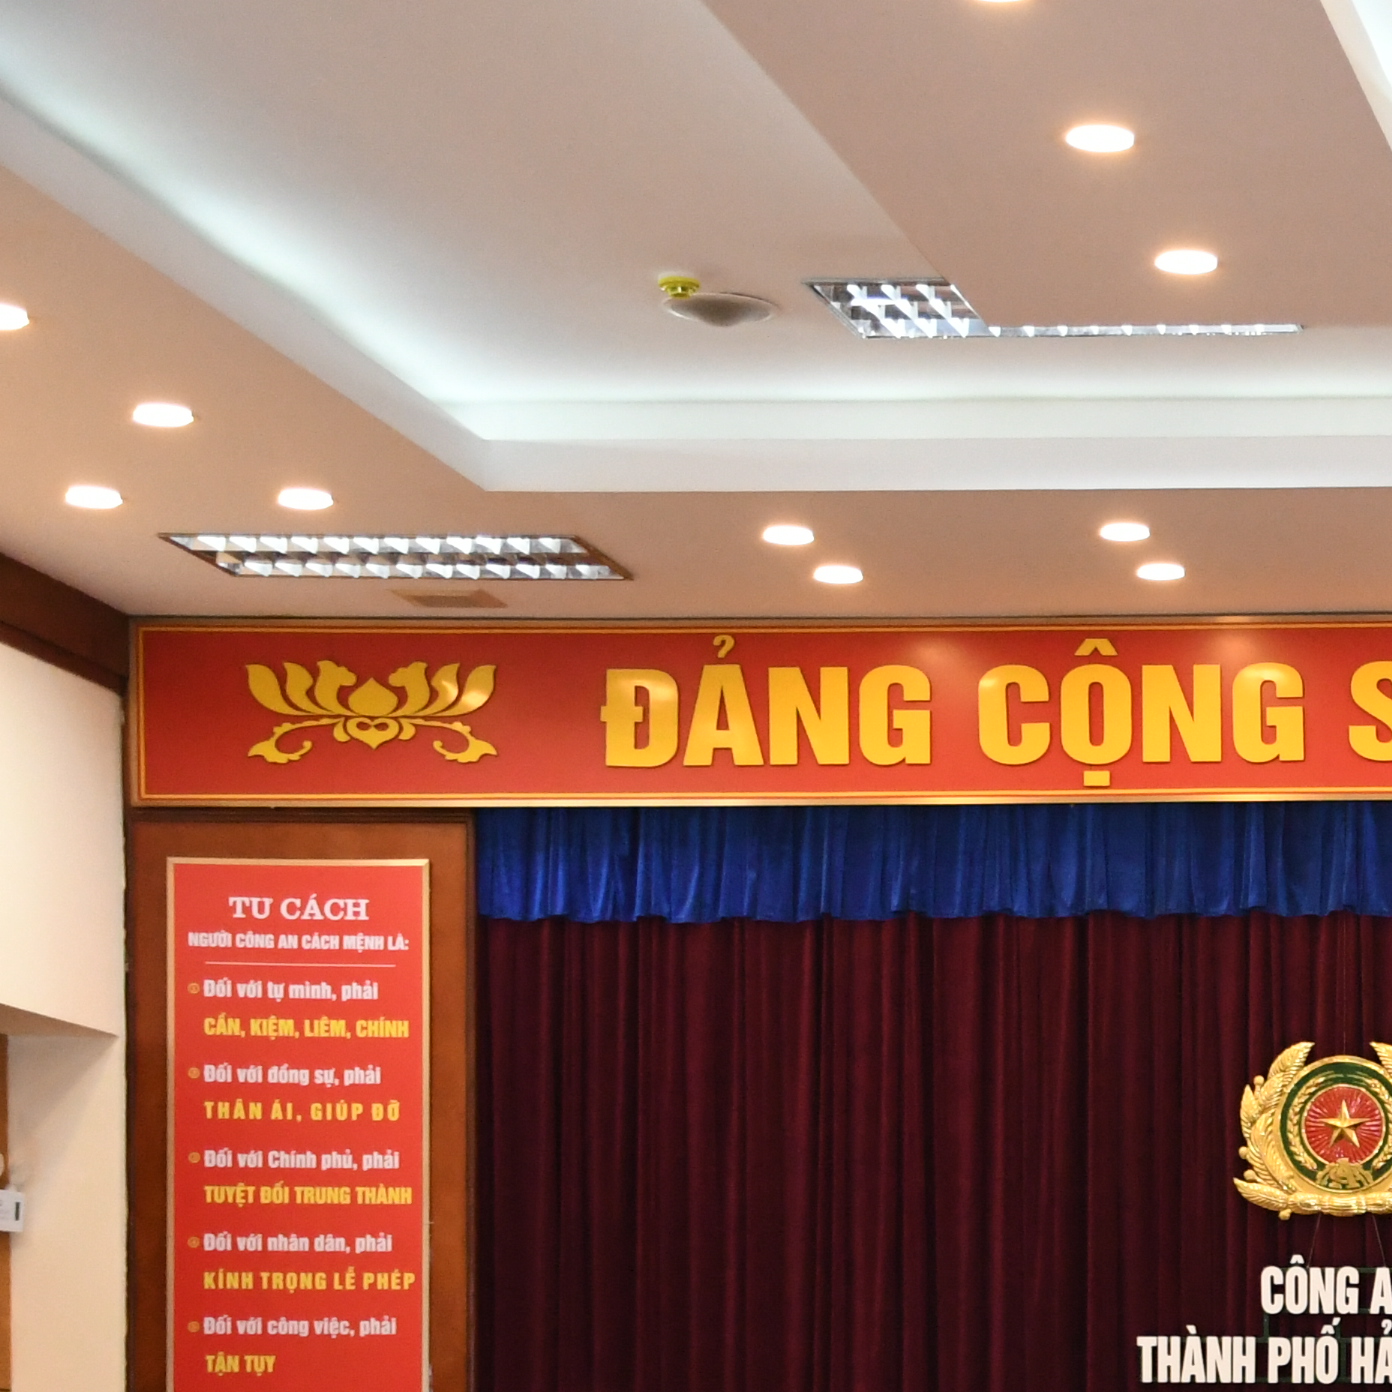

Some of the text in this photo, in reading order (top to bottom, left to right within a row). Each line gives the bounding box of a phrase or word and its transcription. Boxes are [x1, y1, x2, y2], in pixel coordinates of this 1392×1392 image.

[600, 635, 933, 768] ĐẢNG
[977, 639, 1304, 787] CỘNG
[1261, 1255, 1359, 1314] CÔNG
[1137, 1325, 1255, 1383] THÀNH
[1268, 1319, 1340, 1384] PHỐ
